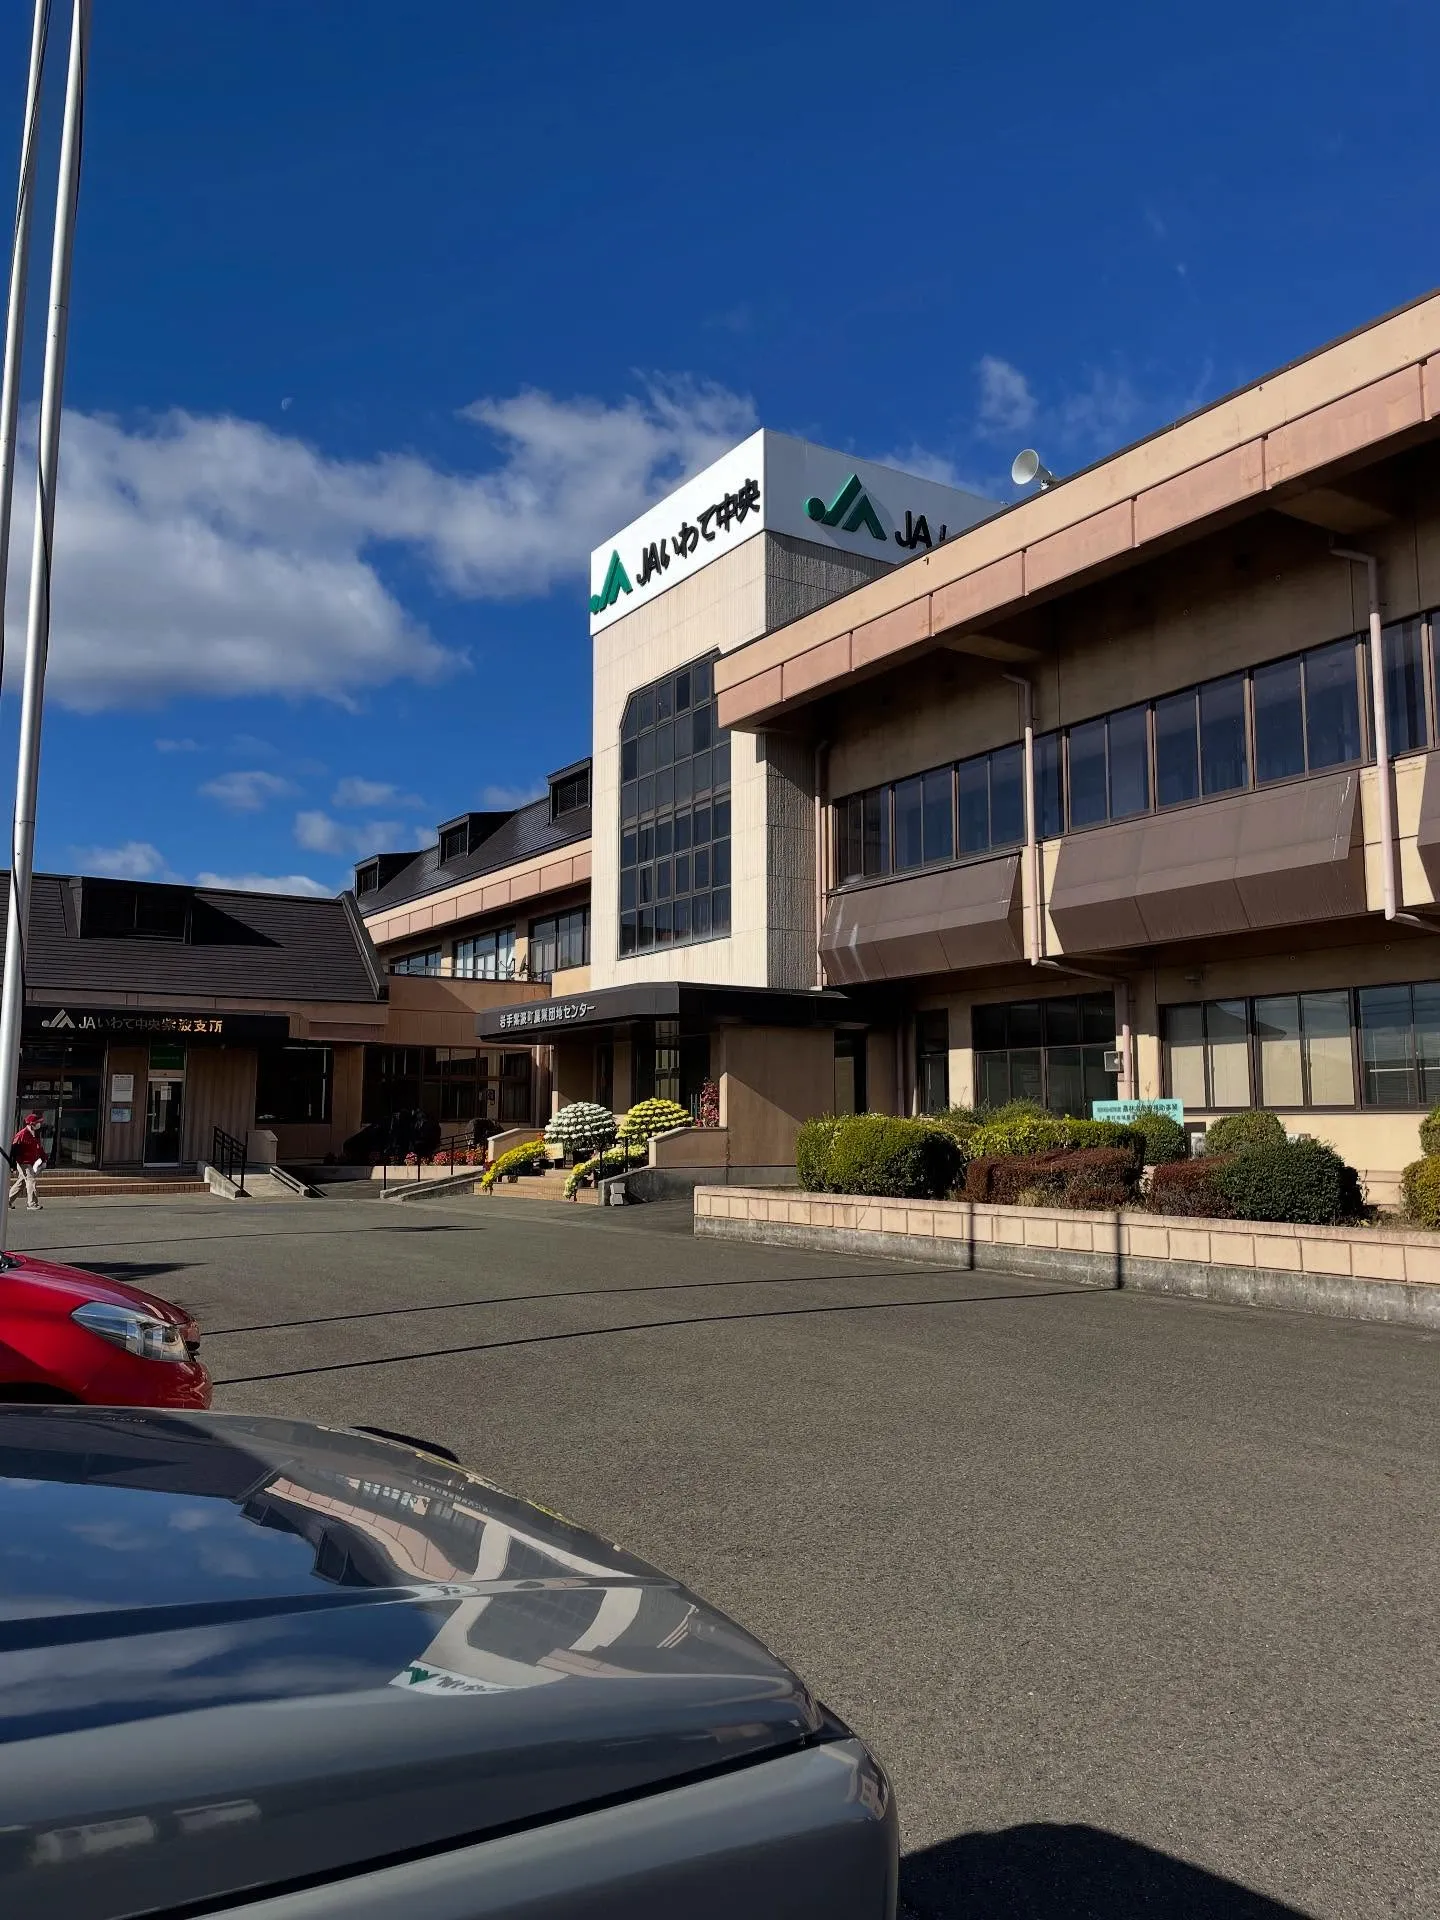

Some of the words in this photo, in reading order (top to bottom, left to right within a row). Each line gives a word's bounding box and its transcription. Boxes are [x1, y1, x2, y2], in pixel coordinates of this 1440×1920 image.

[636, 478, 760, 586] JAいわて中央
